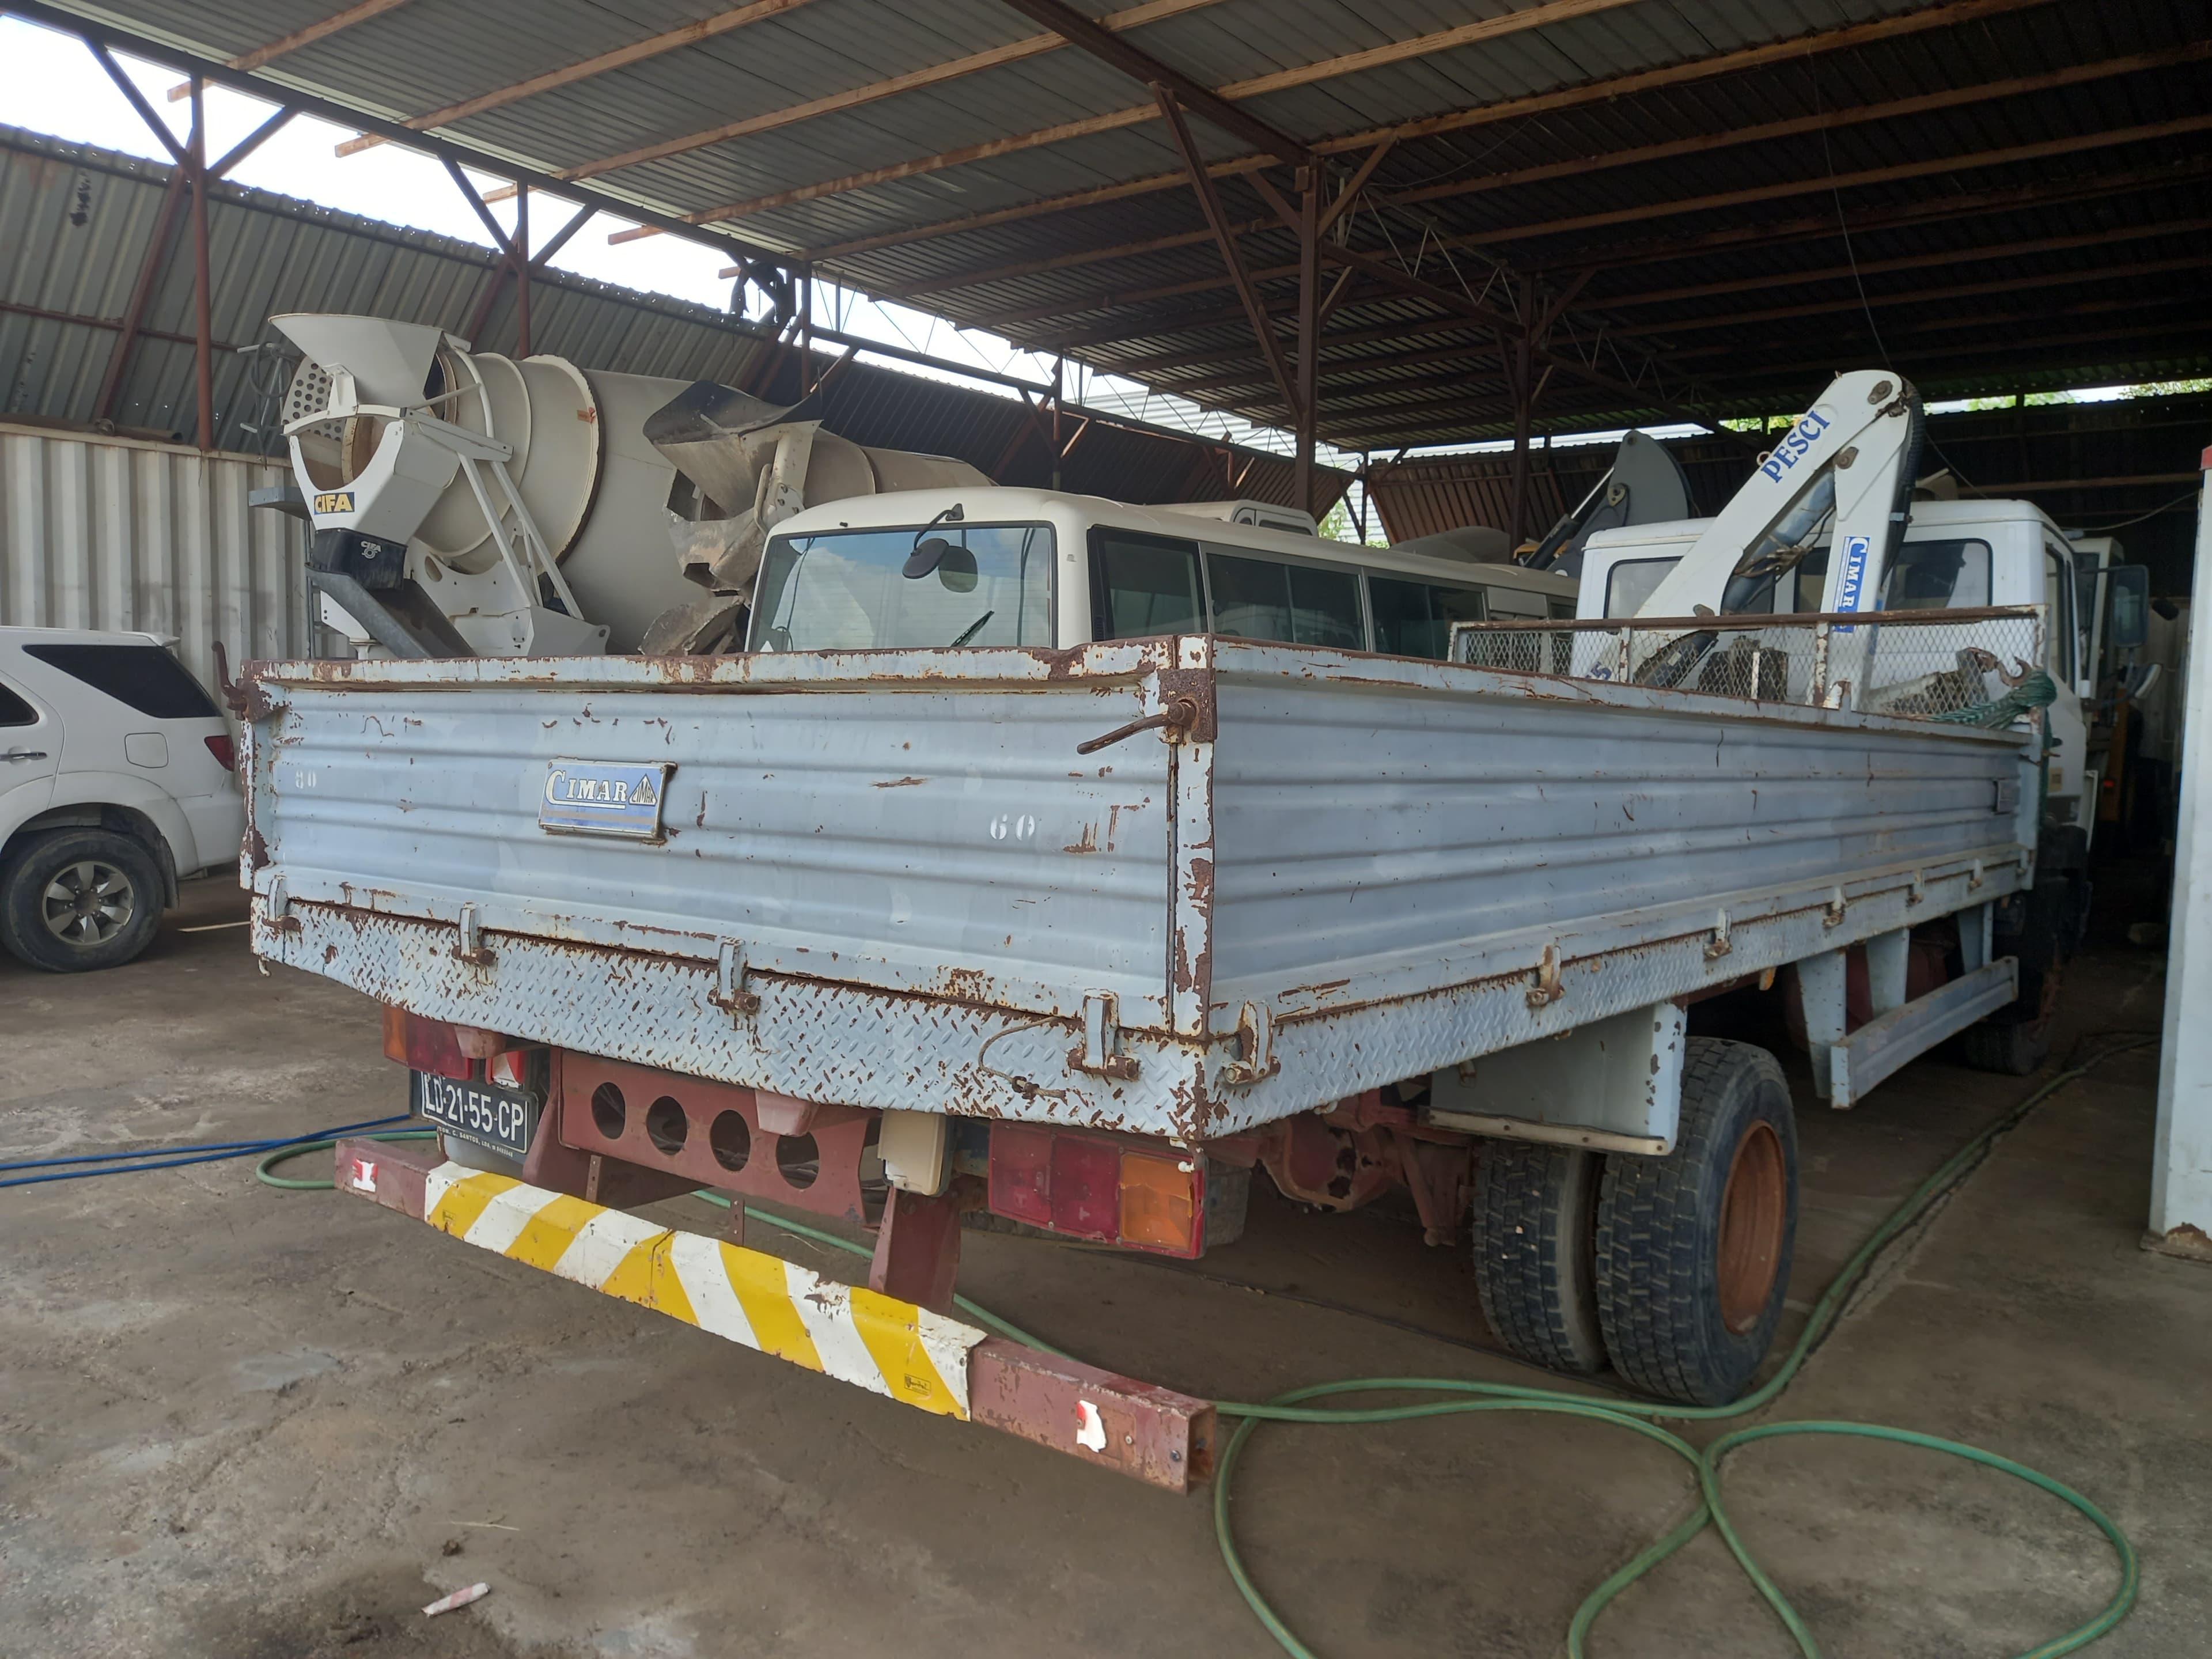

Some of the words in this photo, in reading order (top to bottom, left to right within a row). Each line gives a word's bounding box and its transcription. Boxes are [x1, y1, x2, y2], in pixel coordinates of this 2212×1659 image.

[1760, 410, 1831, 483] PESCI
[315, 494, 353, 513] CIFA
[361, 541, 381, 552] CIFA
[1839, 537, 1870, 608] CIMAR
[295, 770, 316, 789] 80
[545, 770, 628, 809] CIMAR
[631, 781, 654, 804] CIMAR
[990, 813, 1035, 841] 60
